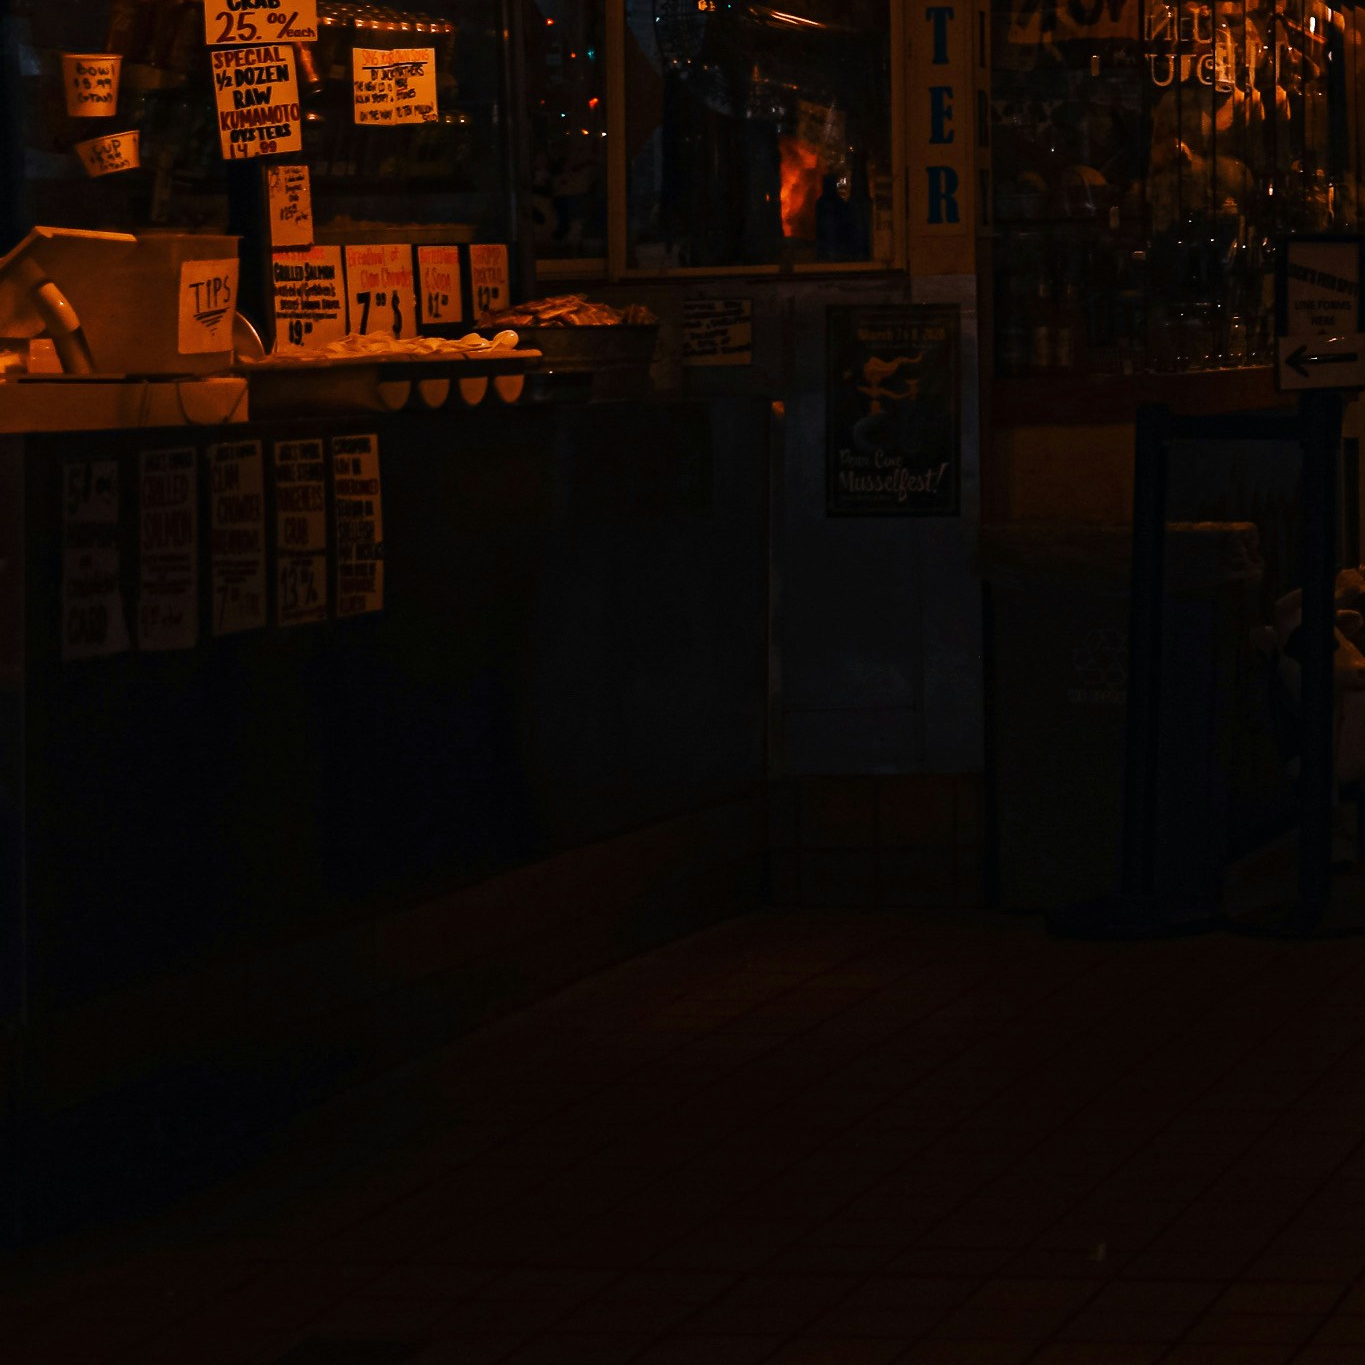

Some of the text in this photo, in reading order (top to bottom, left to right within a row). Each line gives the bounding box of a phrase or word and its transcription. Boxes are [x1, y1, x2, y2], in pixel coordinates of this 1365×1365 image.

[213, 46, 286, 69] SPECIAL
[234, 64, 290, 87] DOZEN
[233, 86, 272, 109] RAW
[220, 102, 300, 131] KUMAMOTO
[230, 123, 292, 143] OYSTERS
[1294, 300, 1352, 310] LINE FORMS
[1311, 315, 1336, 326] HERE
